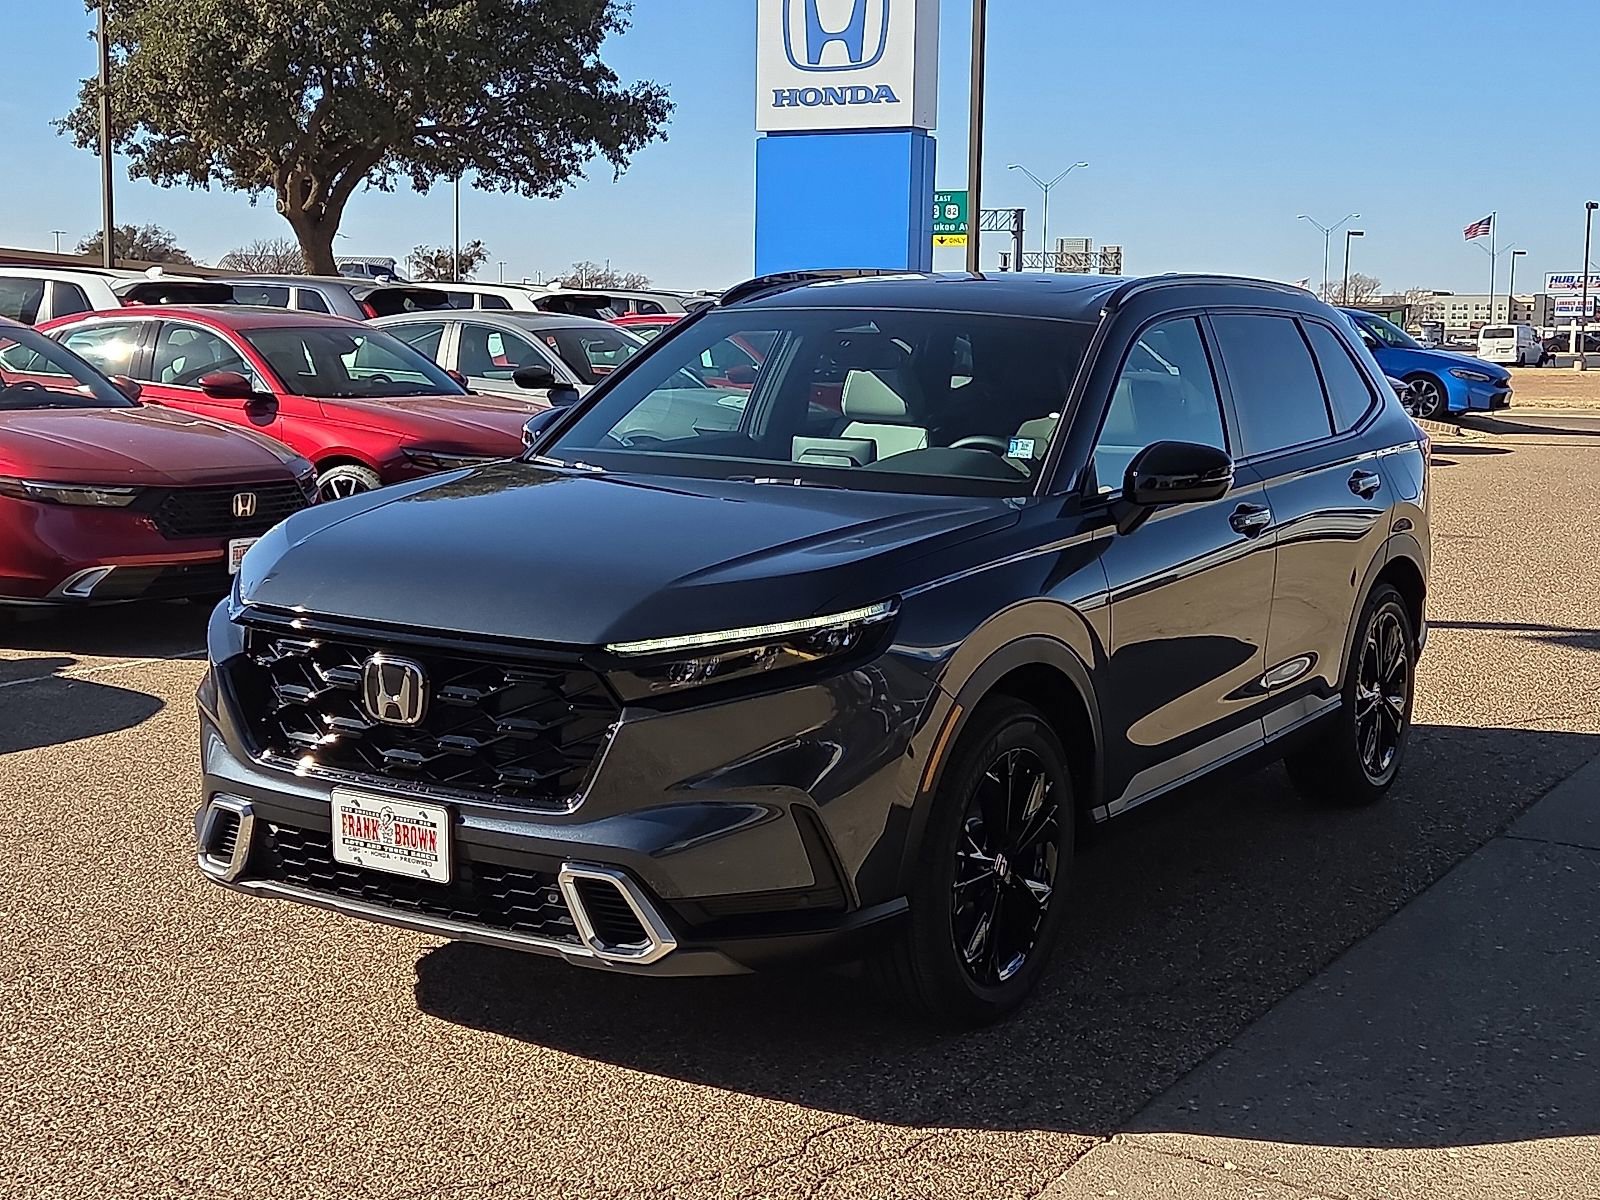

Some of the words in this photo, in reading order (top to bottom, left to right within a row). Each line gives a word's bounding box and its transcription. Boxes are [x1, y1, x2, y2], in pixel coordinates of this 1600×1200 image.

[772, 84, 900, 107] HONDA
[947, 207, 957, 216] 82
[341, 813, 380, 841] FRANK
[394, 823, 437, 853] BROWN
[371, 851, 391, 859] HONDA
